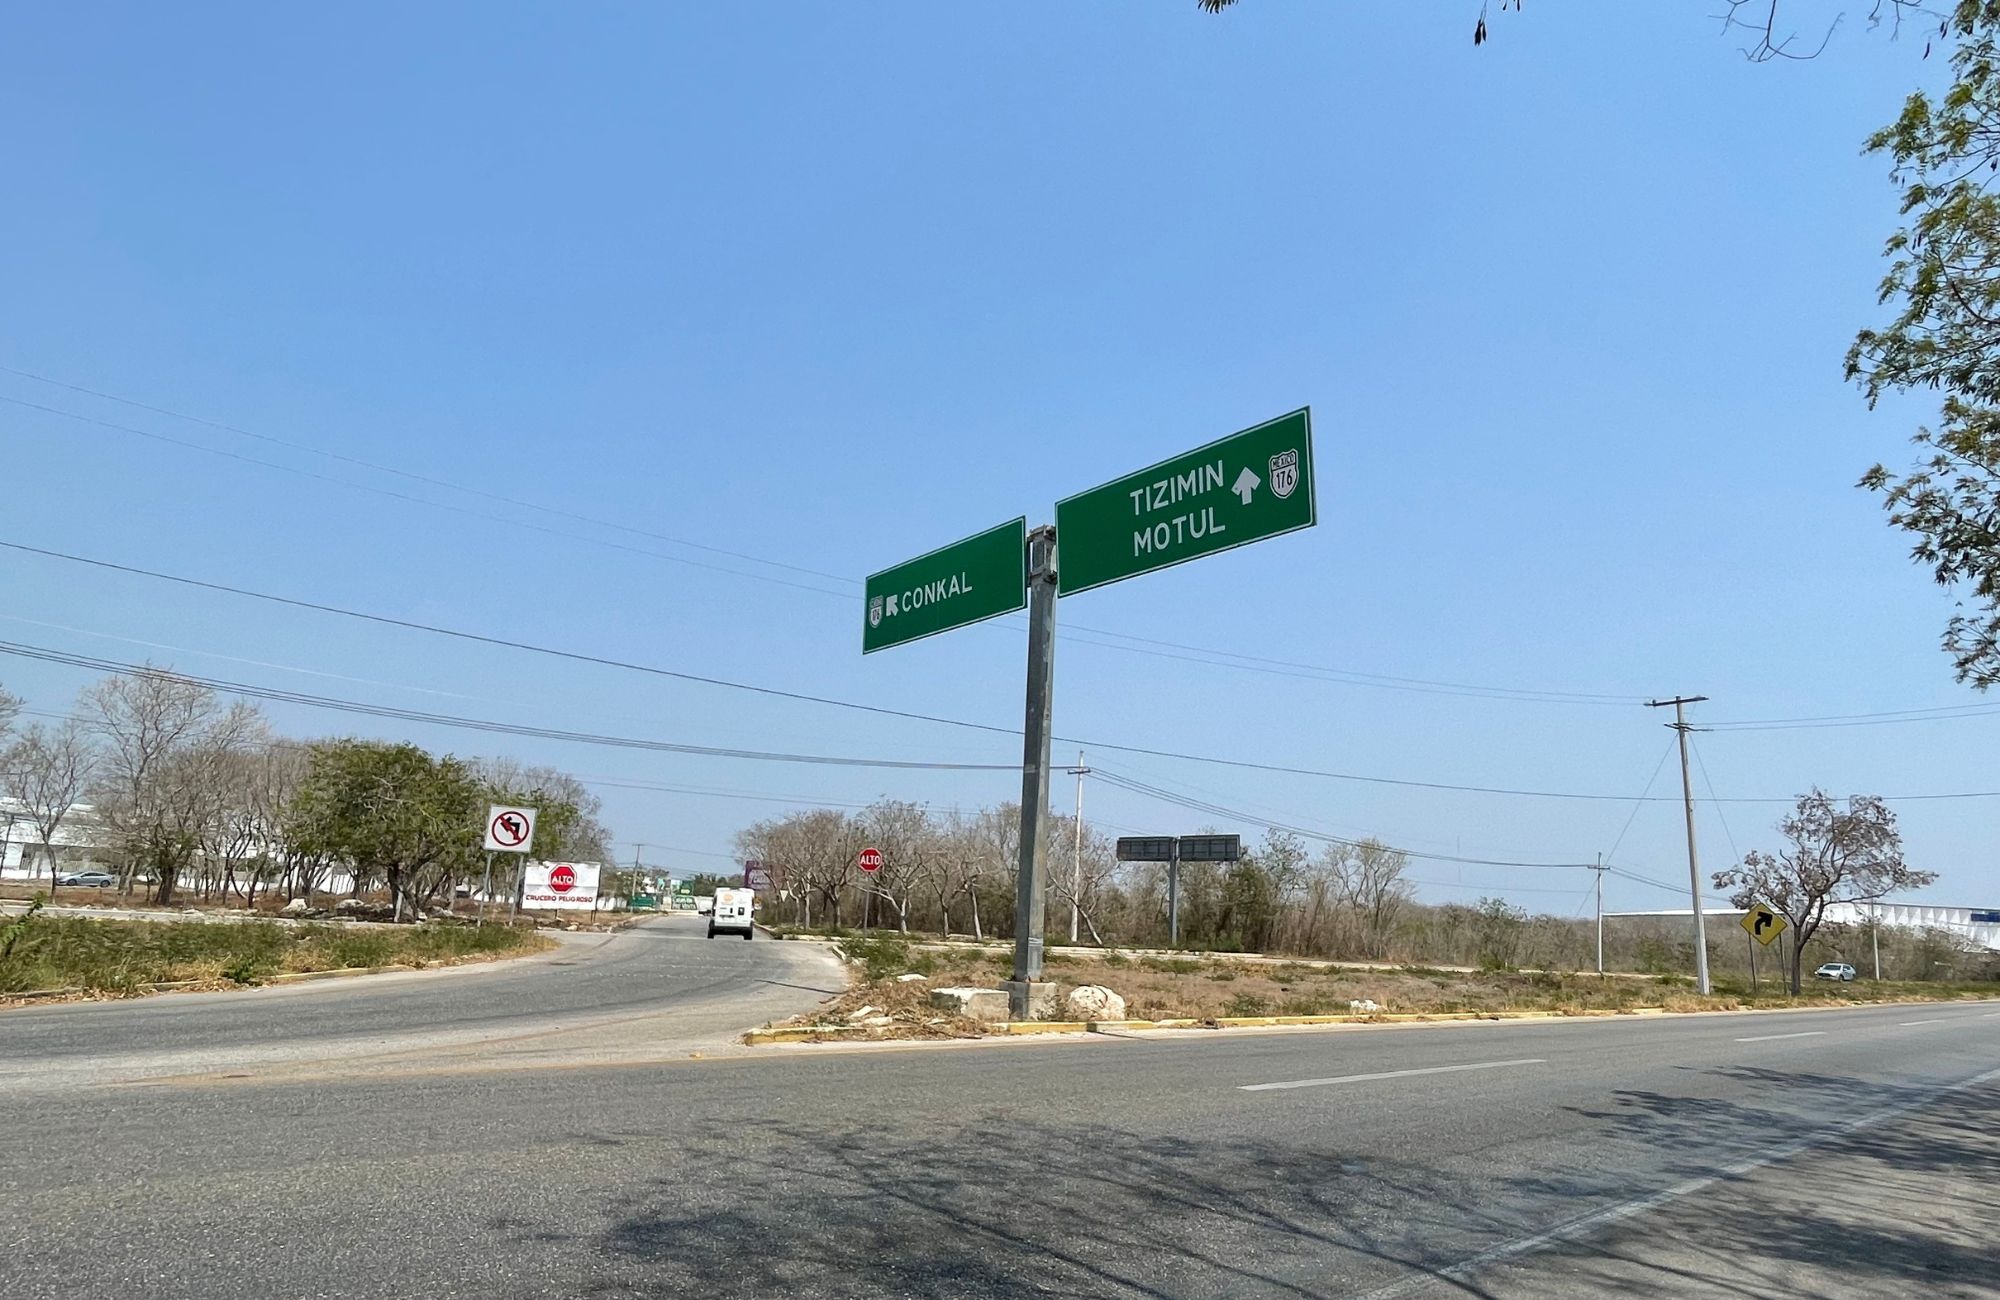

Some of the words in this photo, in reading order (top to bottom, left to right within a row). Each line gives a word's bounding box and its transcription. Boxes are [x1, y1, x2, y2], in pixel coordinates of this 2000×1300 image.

[1129, 459, 1224, 516] TIZIMIN
[1275, 469, 1293, 489] 176
[1133, 506, 1226, 557] MOTUL
[901, 571, 973, 613] CONKAL
[860, 855, 881, 865] ALTO
[551, 875, 574, 886] ALTO
[525, 894, 557, 902] CRUCERO
[558, 895, 594, 903] PELIGROSO
